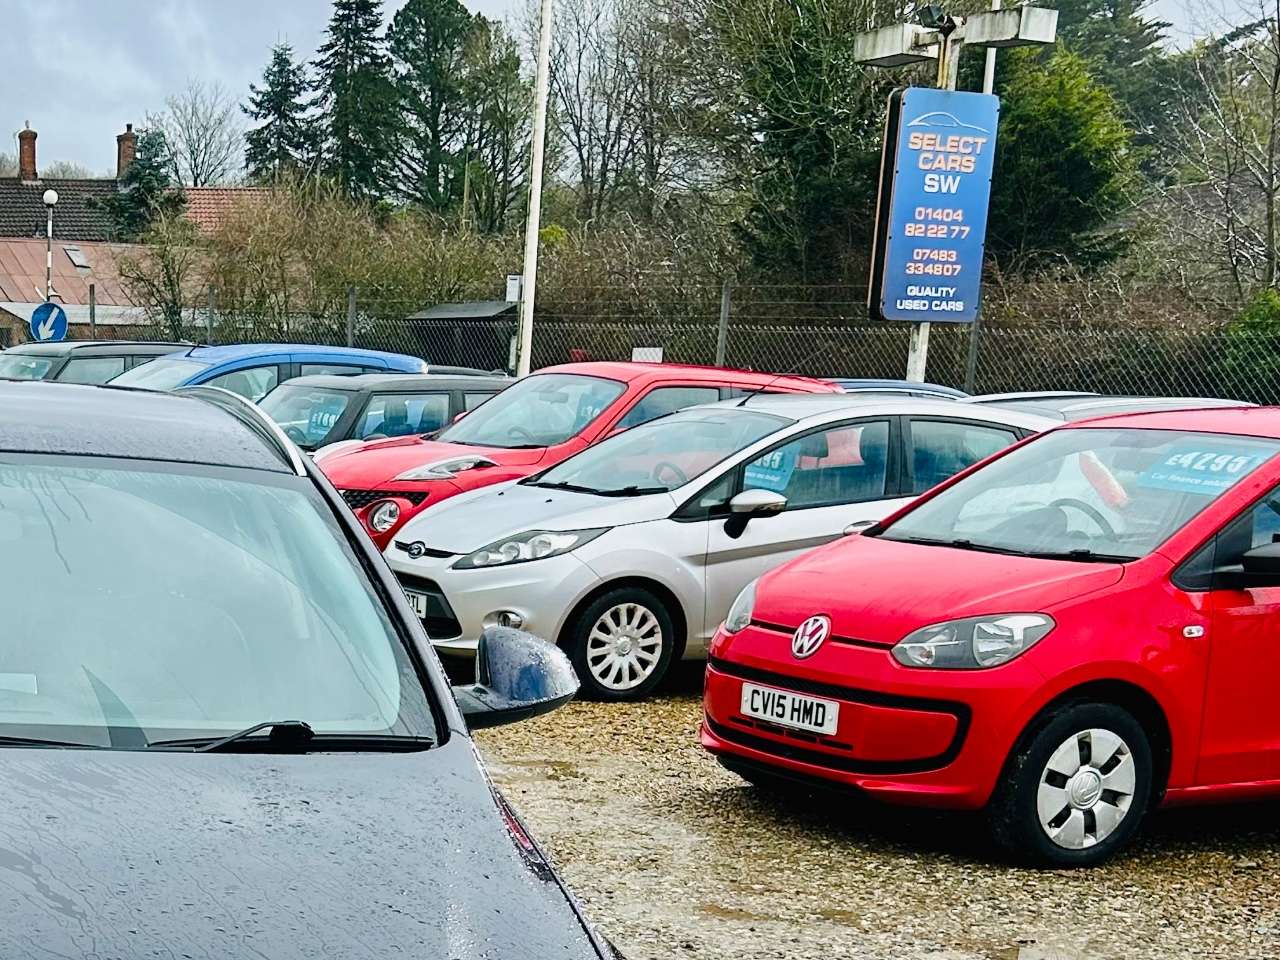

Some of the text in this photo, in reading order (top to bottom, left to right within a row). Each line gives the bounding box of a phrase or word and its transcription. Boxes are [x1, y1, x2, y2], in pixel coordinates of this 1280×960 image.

[908, 132, 987, 154] SELECT
[918, 152, 976, 173] CARS
[923, 174, 961, 194] SW
[914, 207, 964, 222] 01404
[905, 263, 962, 276] 334807
[906, 285, 957, 298] QUALITY
[896, 299, 964, 312] USED CARS
[1165, 451, 1254, 473] £4295
[750, 689, 826, 728] CV15 HMD
